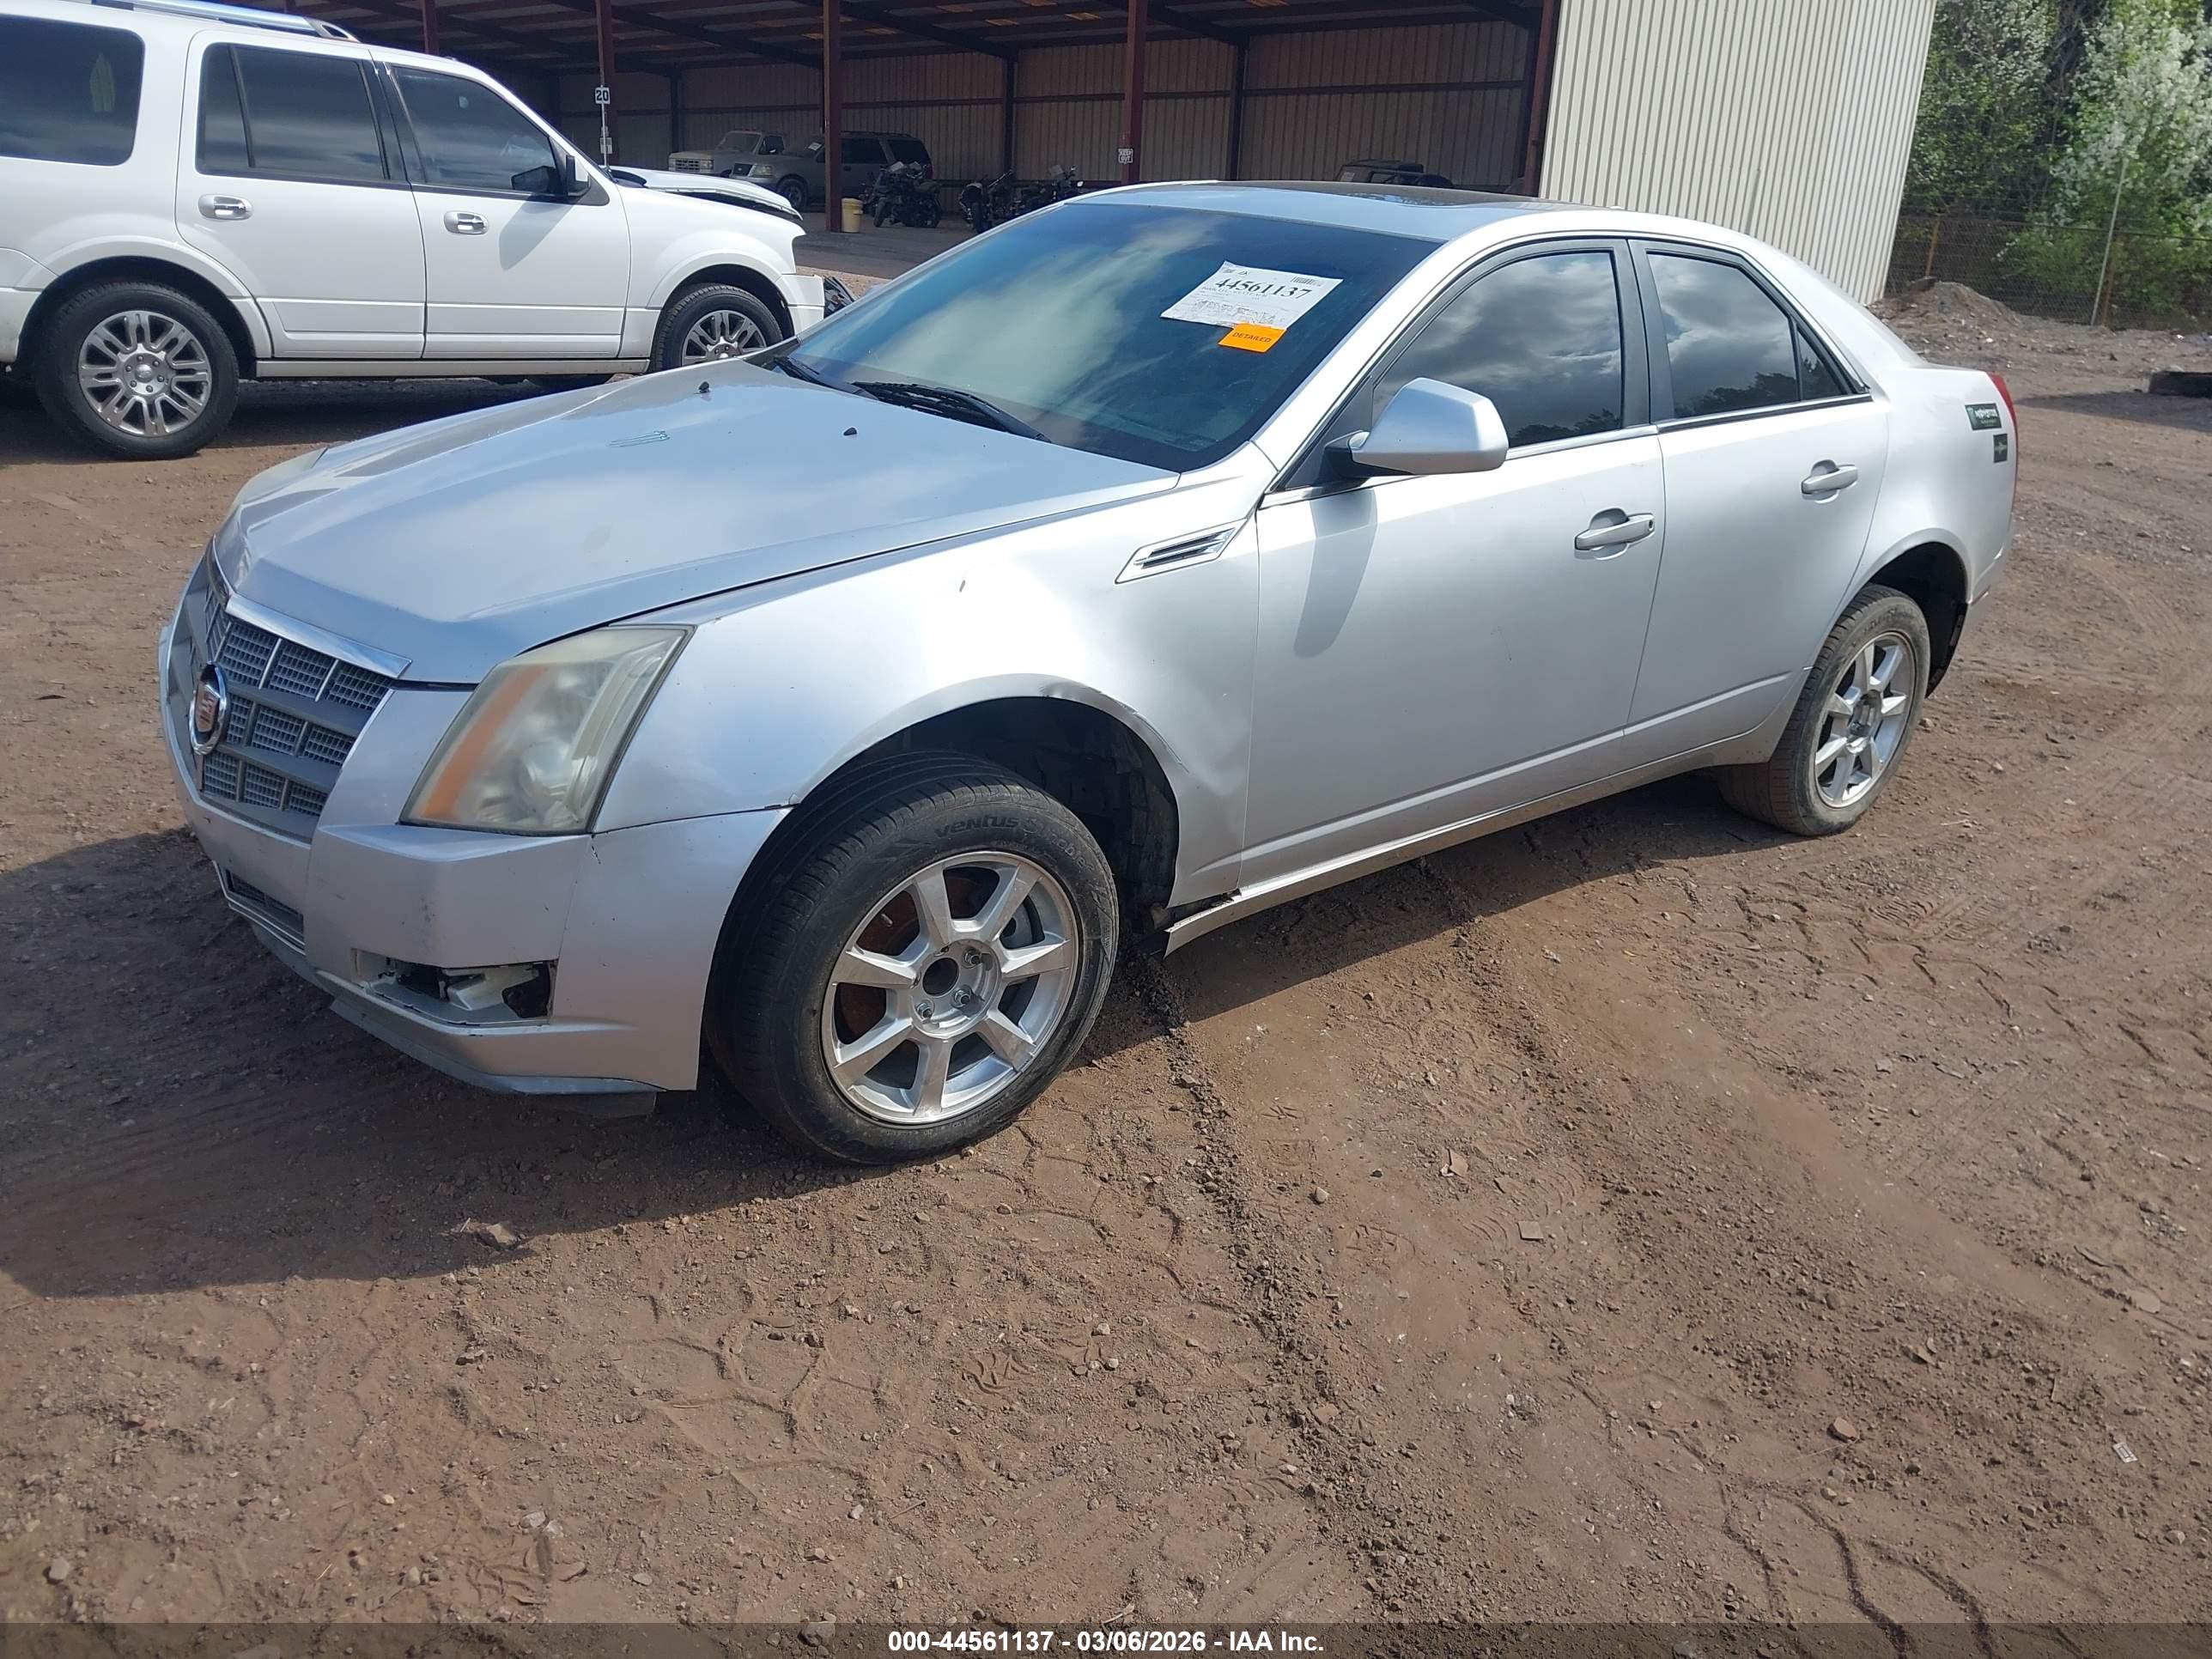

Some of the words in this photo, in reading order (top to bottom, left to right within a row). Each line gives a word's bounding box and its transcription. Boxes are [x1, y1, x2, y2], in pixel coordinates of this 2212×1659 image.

[596, 89, 609, 101] 20
[1215, 278, 1313, 300] 44561137
[1231, 331, 1272, 343] DETAILED
